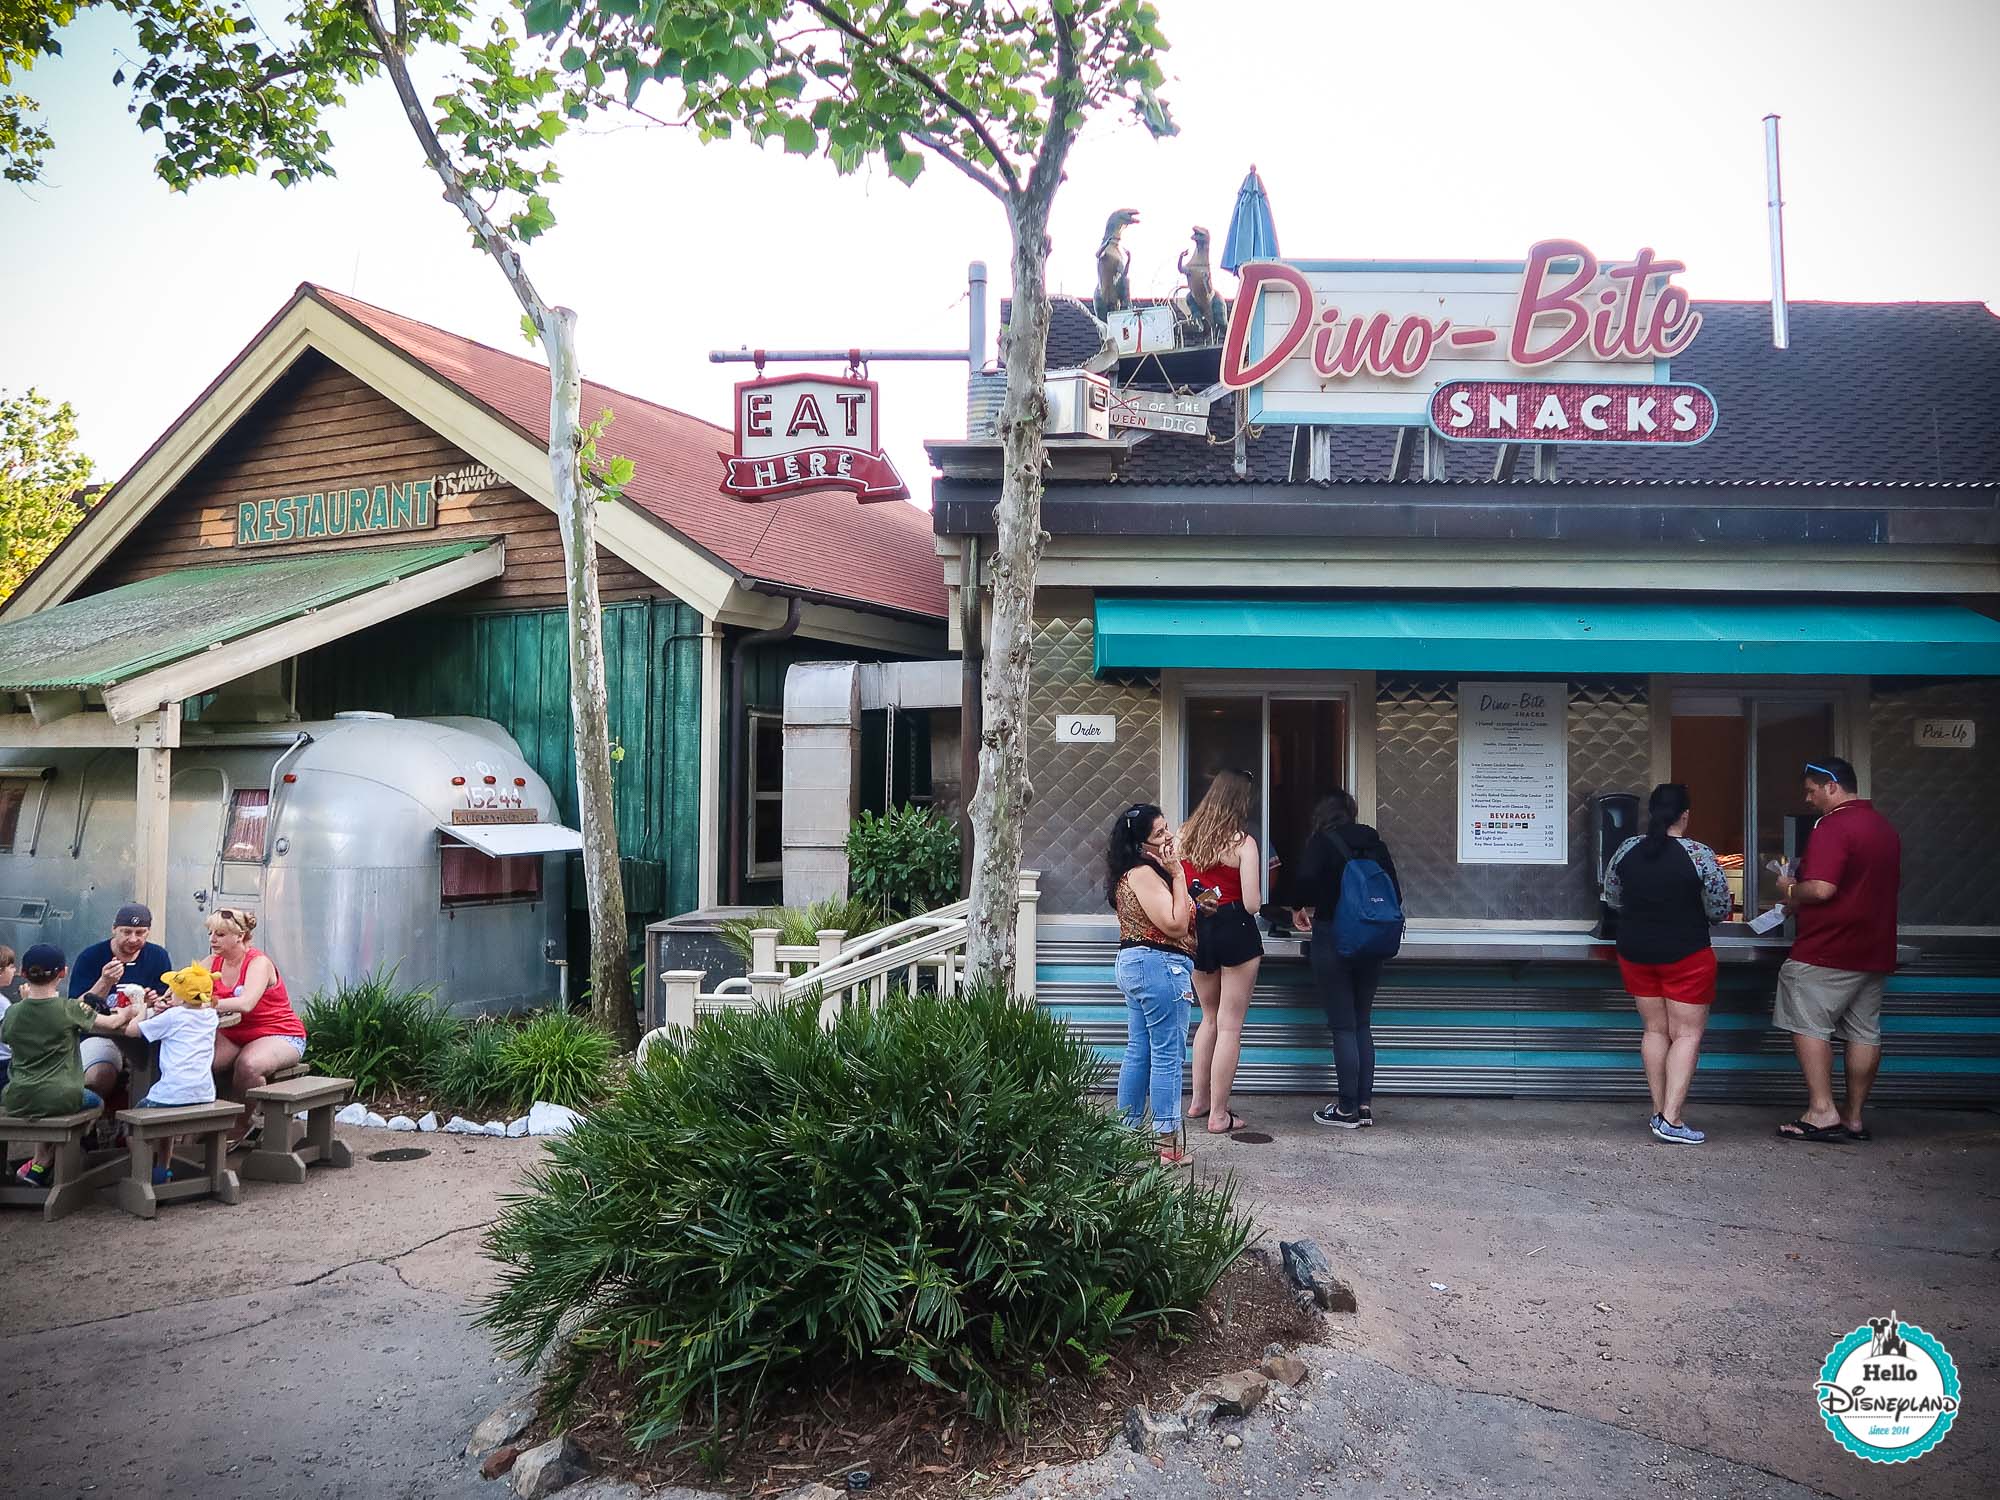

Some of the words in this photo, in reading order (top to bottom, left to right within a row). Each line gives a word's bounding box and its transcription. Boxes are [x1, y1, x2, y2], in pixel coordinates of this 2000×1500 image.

[1220, 239, 1703, 390] Dino-Bite
[747, 393, 866, 437] EAT
[1112, 413, 1147, 427] UEEN
[1160, 415, 1197, 434] DIG
[1148, 402, 1167, 413] OF
[1175, 402, 1200, 413] THE
[1449, 391, 1698, 432] SNACKS
[753, 452, 854, 488] HERE
[238, 480, 431, 544] RESTAURANT
[1070, 721, 1102, 737] Order
[465, 786, 522, 808] 15244
